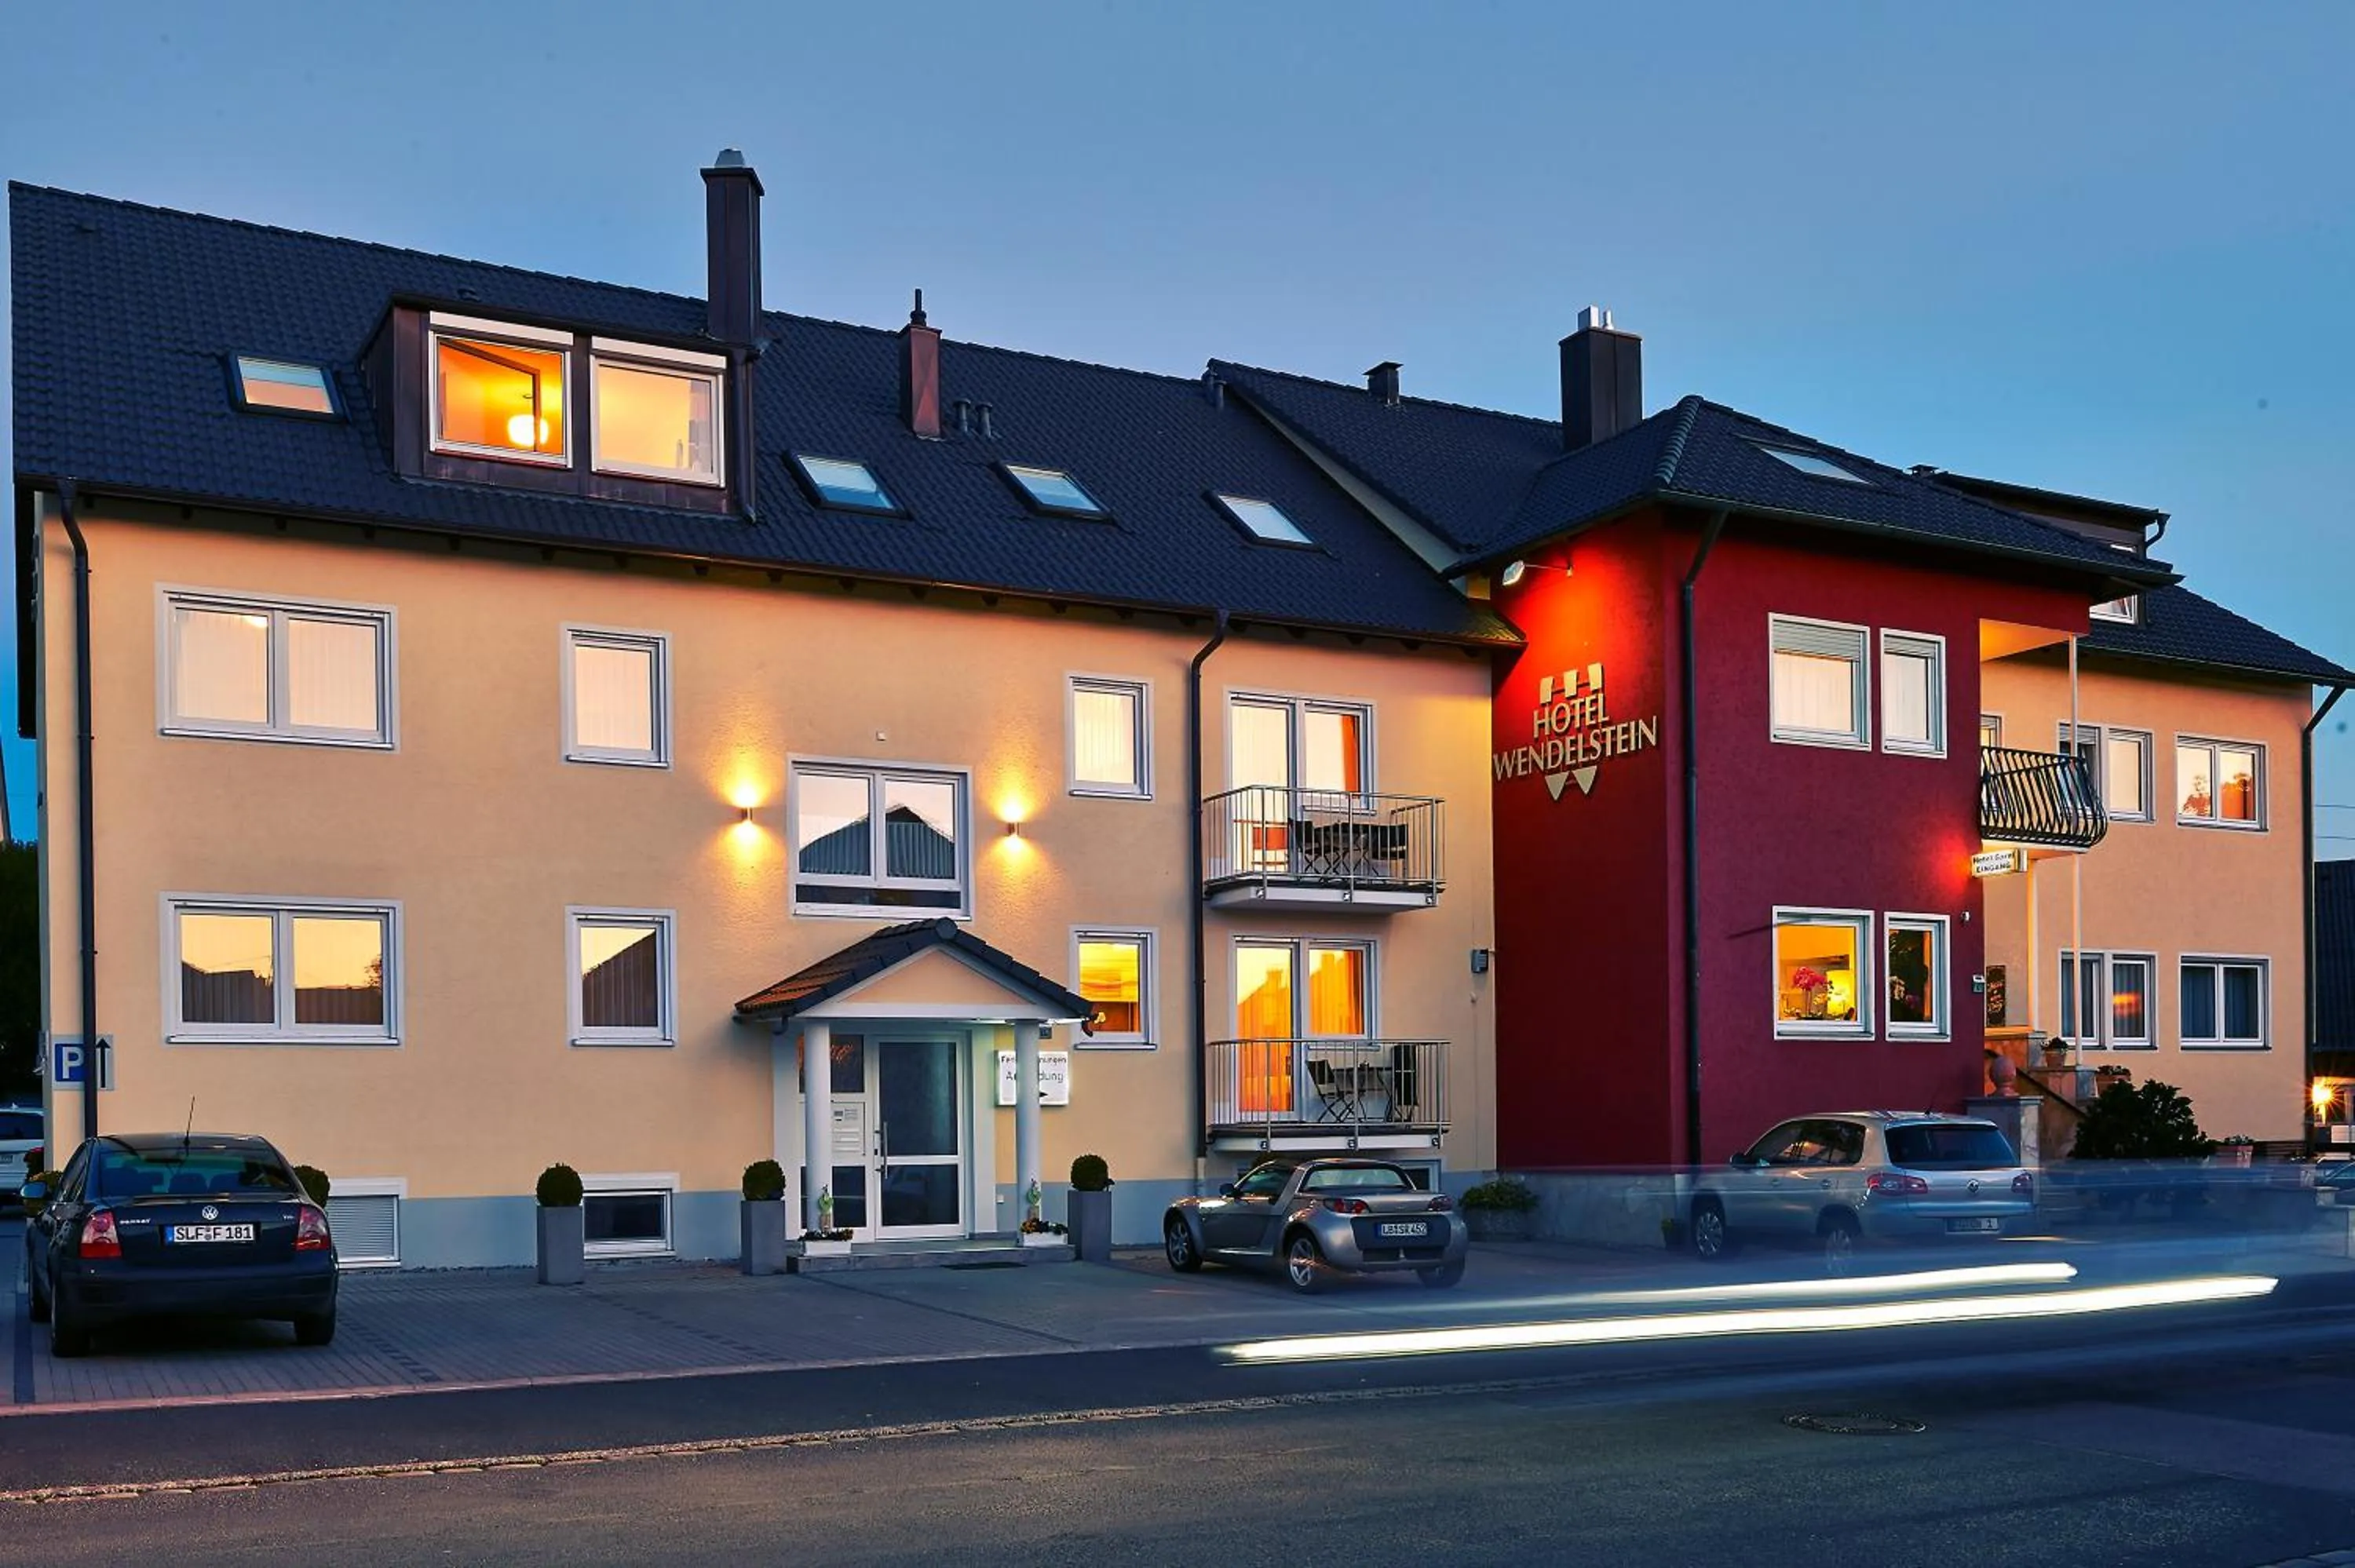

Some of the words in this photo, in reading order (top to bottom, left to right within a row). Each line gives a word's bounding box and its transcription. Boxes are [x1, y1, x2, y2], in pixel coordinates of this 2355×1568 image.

[1533, 693, 1609, 738] HOTEL
[1492, 715, 1657, 782] WENDELSTEIN
[1973, 855, 1993, 863] Hotel
[1976, 862, 2010, 873] EINGANG
[62, 1046, 85, 1079] P
